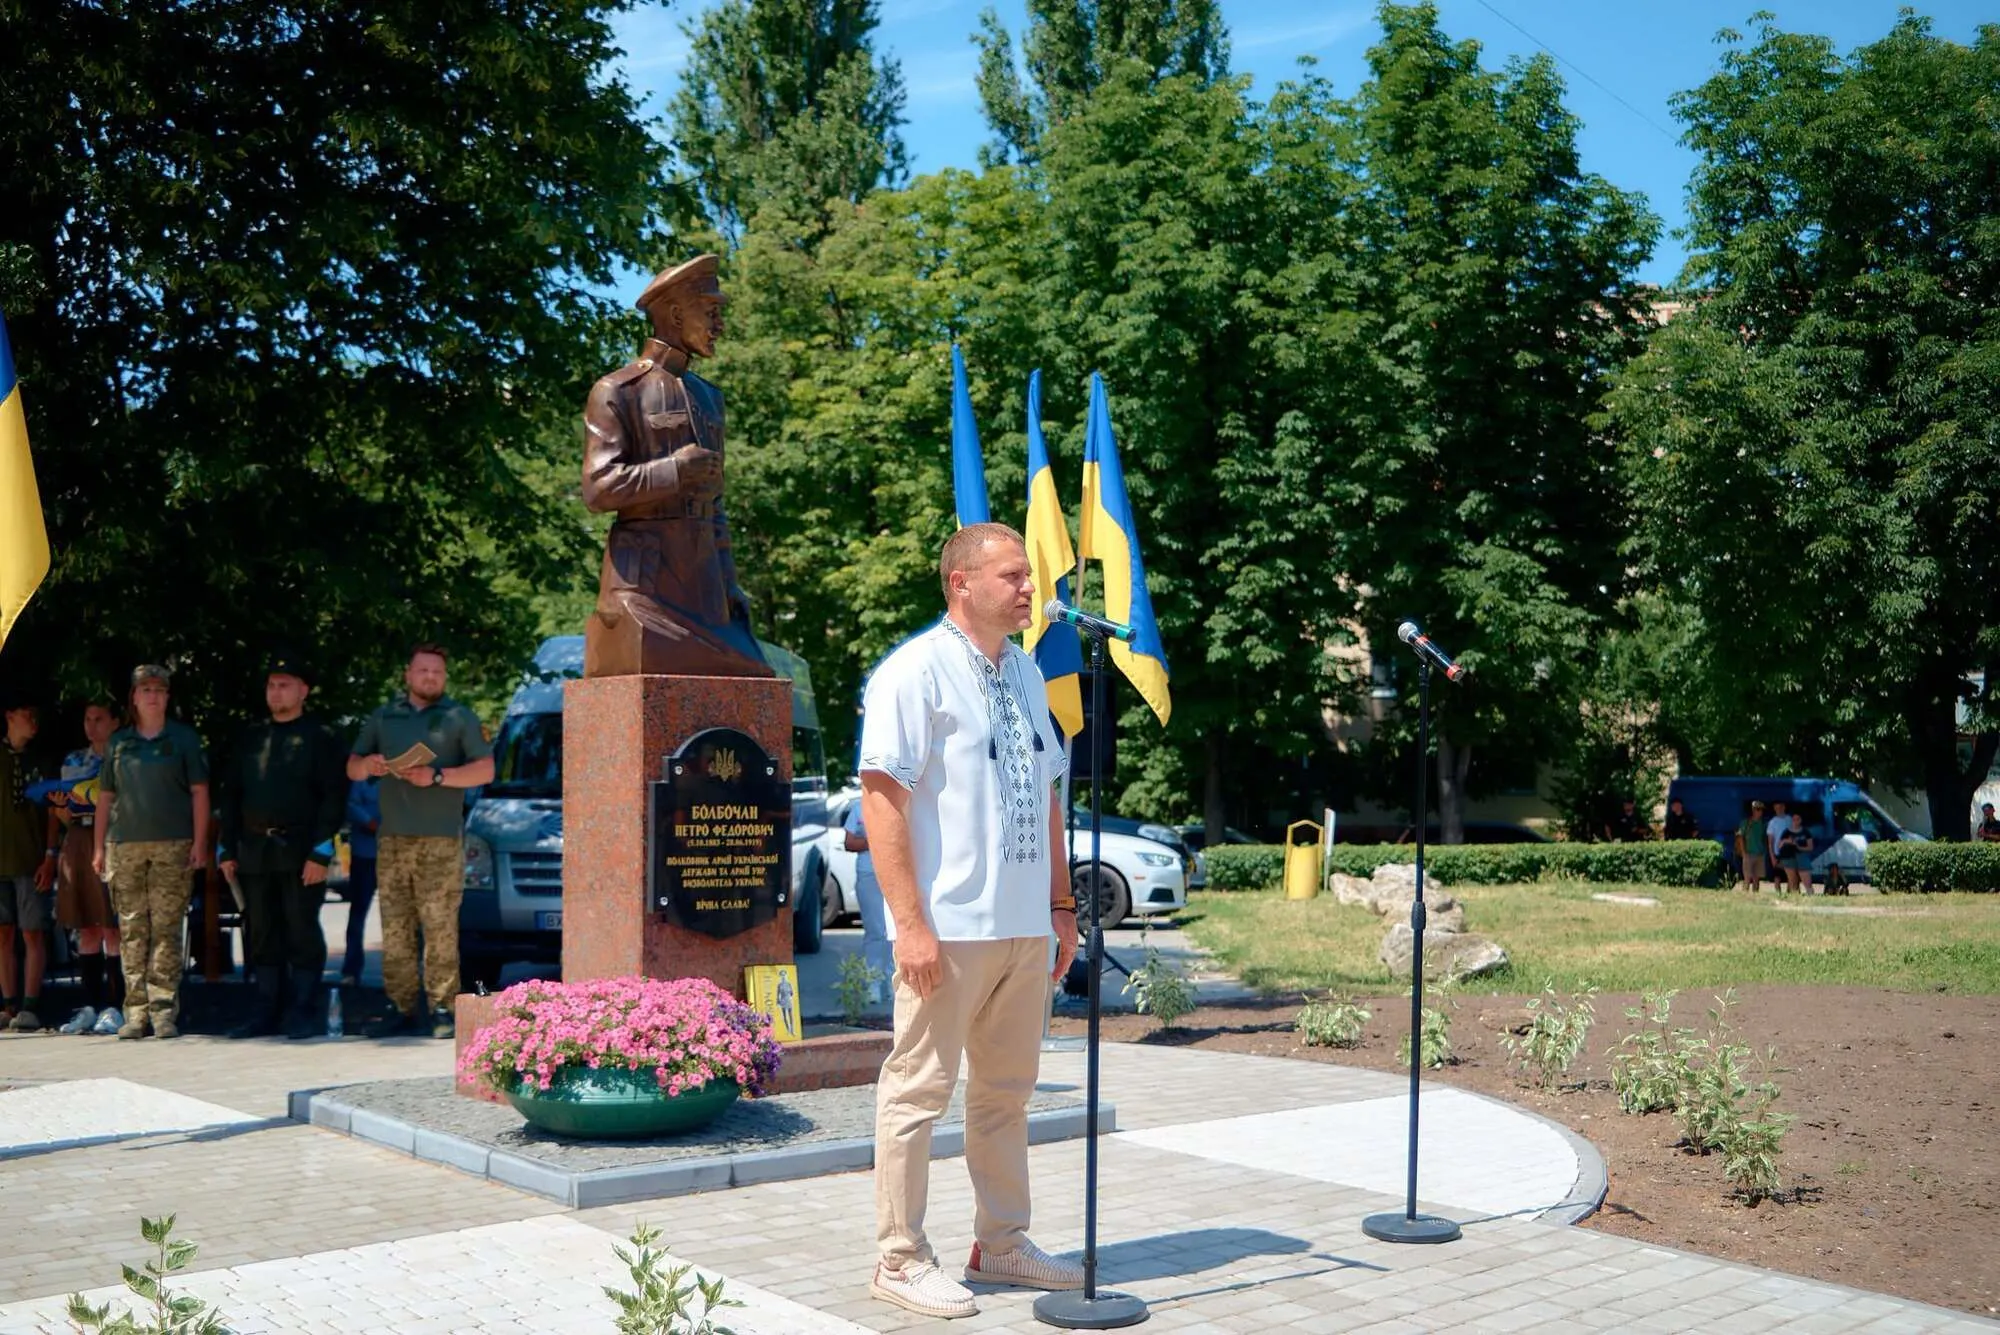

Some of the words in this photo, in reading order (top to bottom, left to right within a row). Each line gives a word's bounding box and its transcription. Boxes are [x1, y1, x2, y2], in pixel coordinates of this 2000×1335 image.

[692, 804, 758, 820] БОЛБОЧАН
[675, 824, 709, 837] ПЕТРО
[712, 823, 774, 837] ФЕДОРОВИЧ
[721, 898, 750, 909] СЛАВА!
